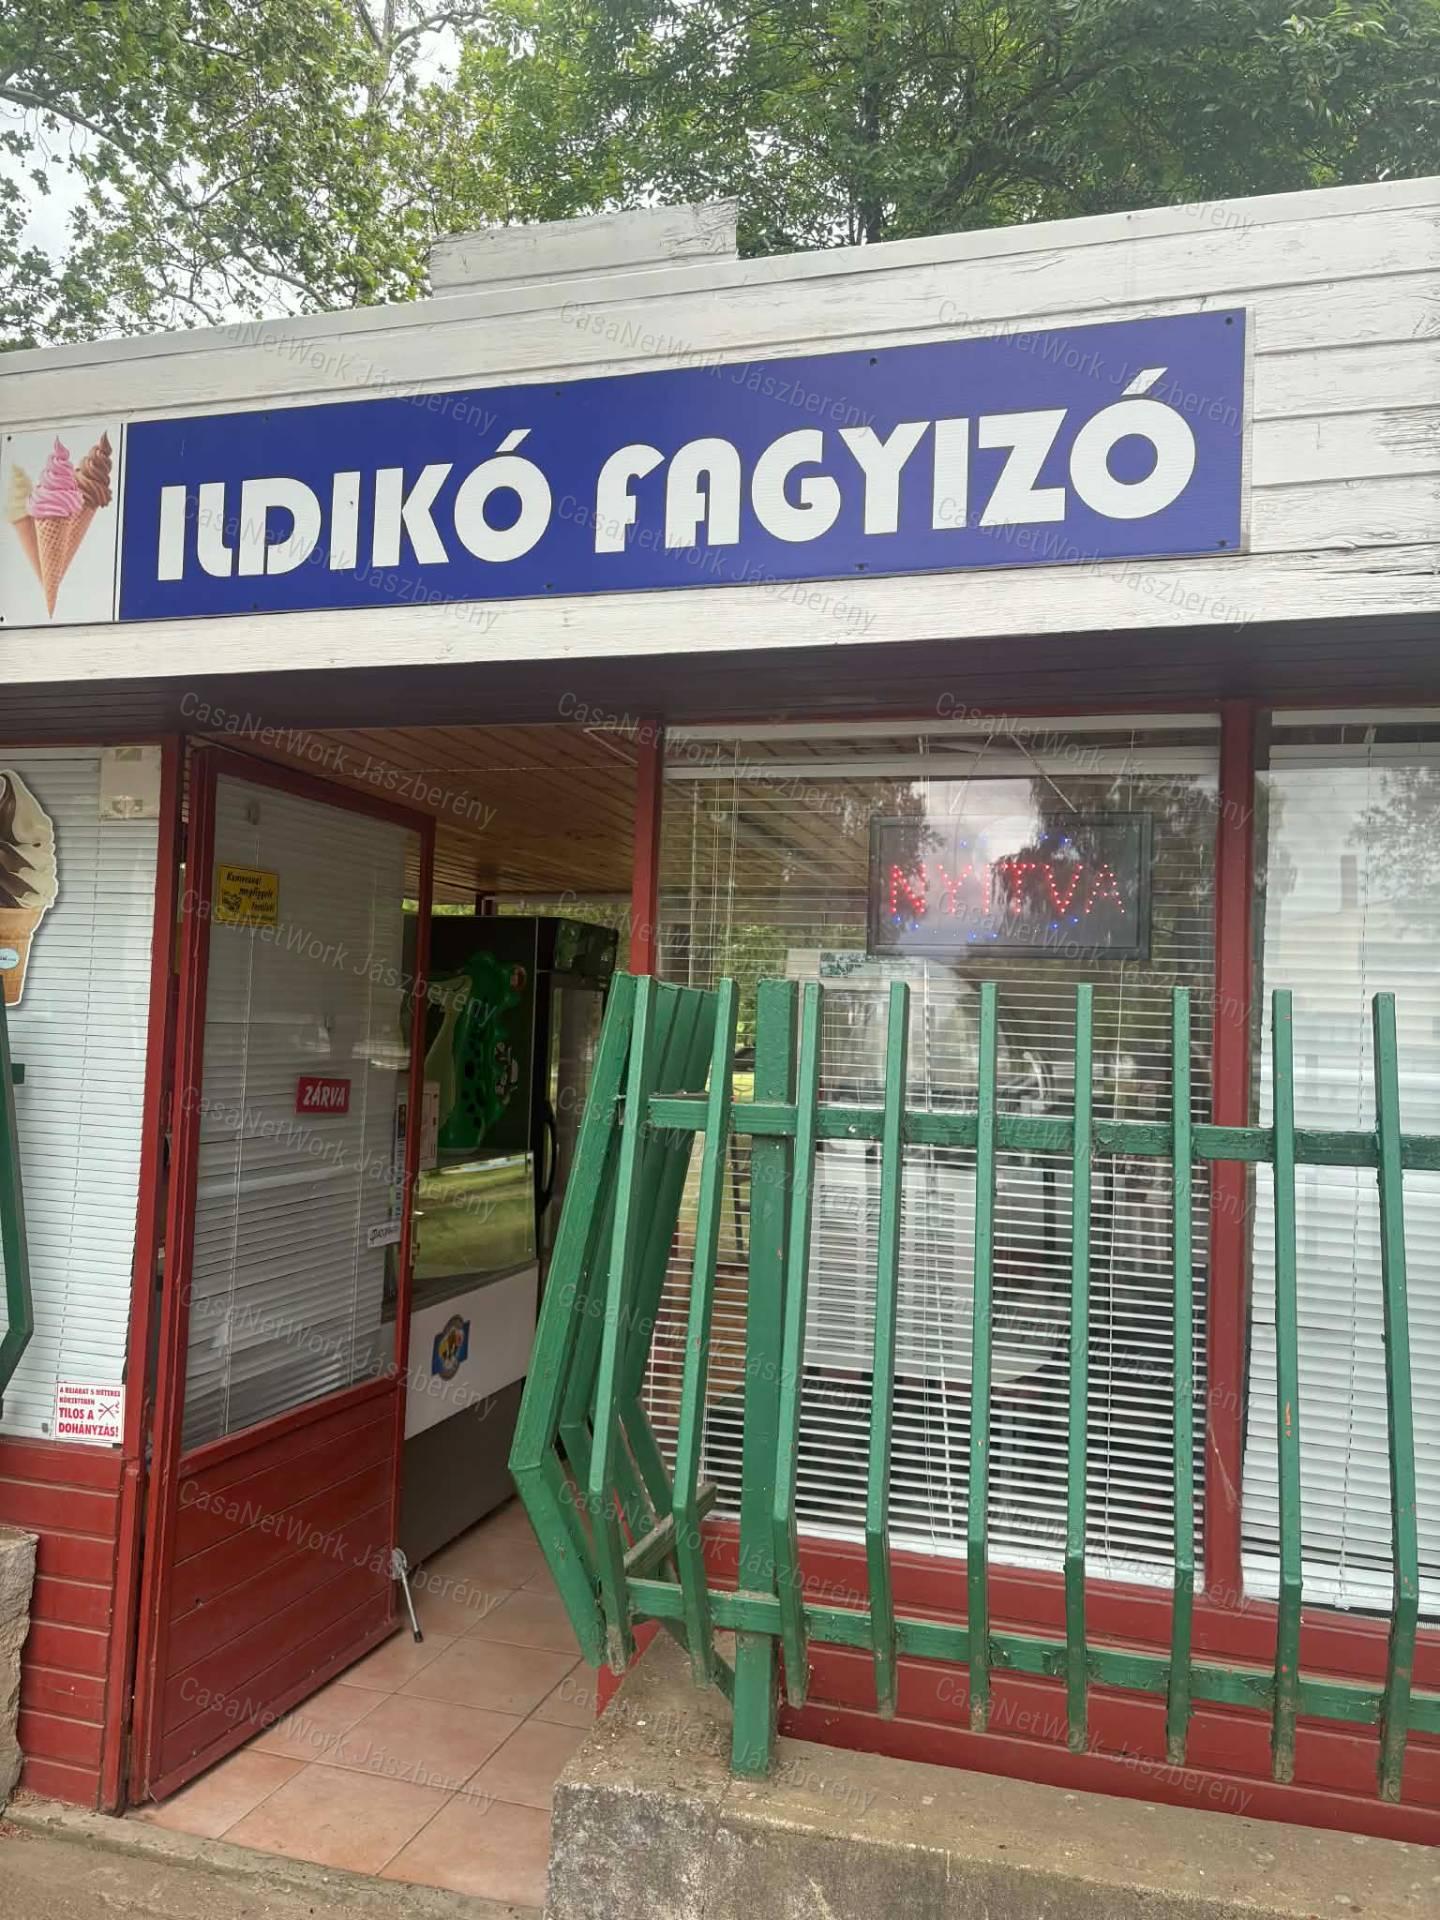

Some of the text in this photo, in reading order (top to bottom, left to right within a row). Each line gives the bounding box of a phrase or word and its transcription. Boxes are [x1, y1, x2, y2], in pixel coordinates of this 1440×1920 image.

[157, 366, 1197, 582] ILDIKÓ FAGYIZÓ
[889, 861, 1126, 916] NYITVA
[302, 1080, 346, 1107] ZÁRVA
[59, 1407, 94, 1420] TILOS A
[58, 1420, 119, 1437] DOHÁNYZÁS!
